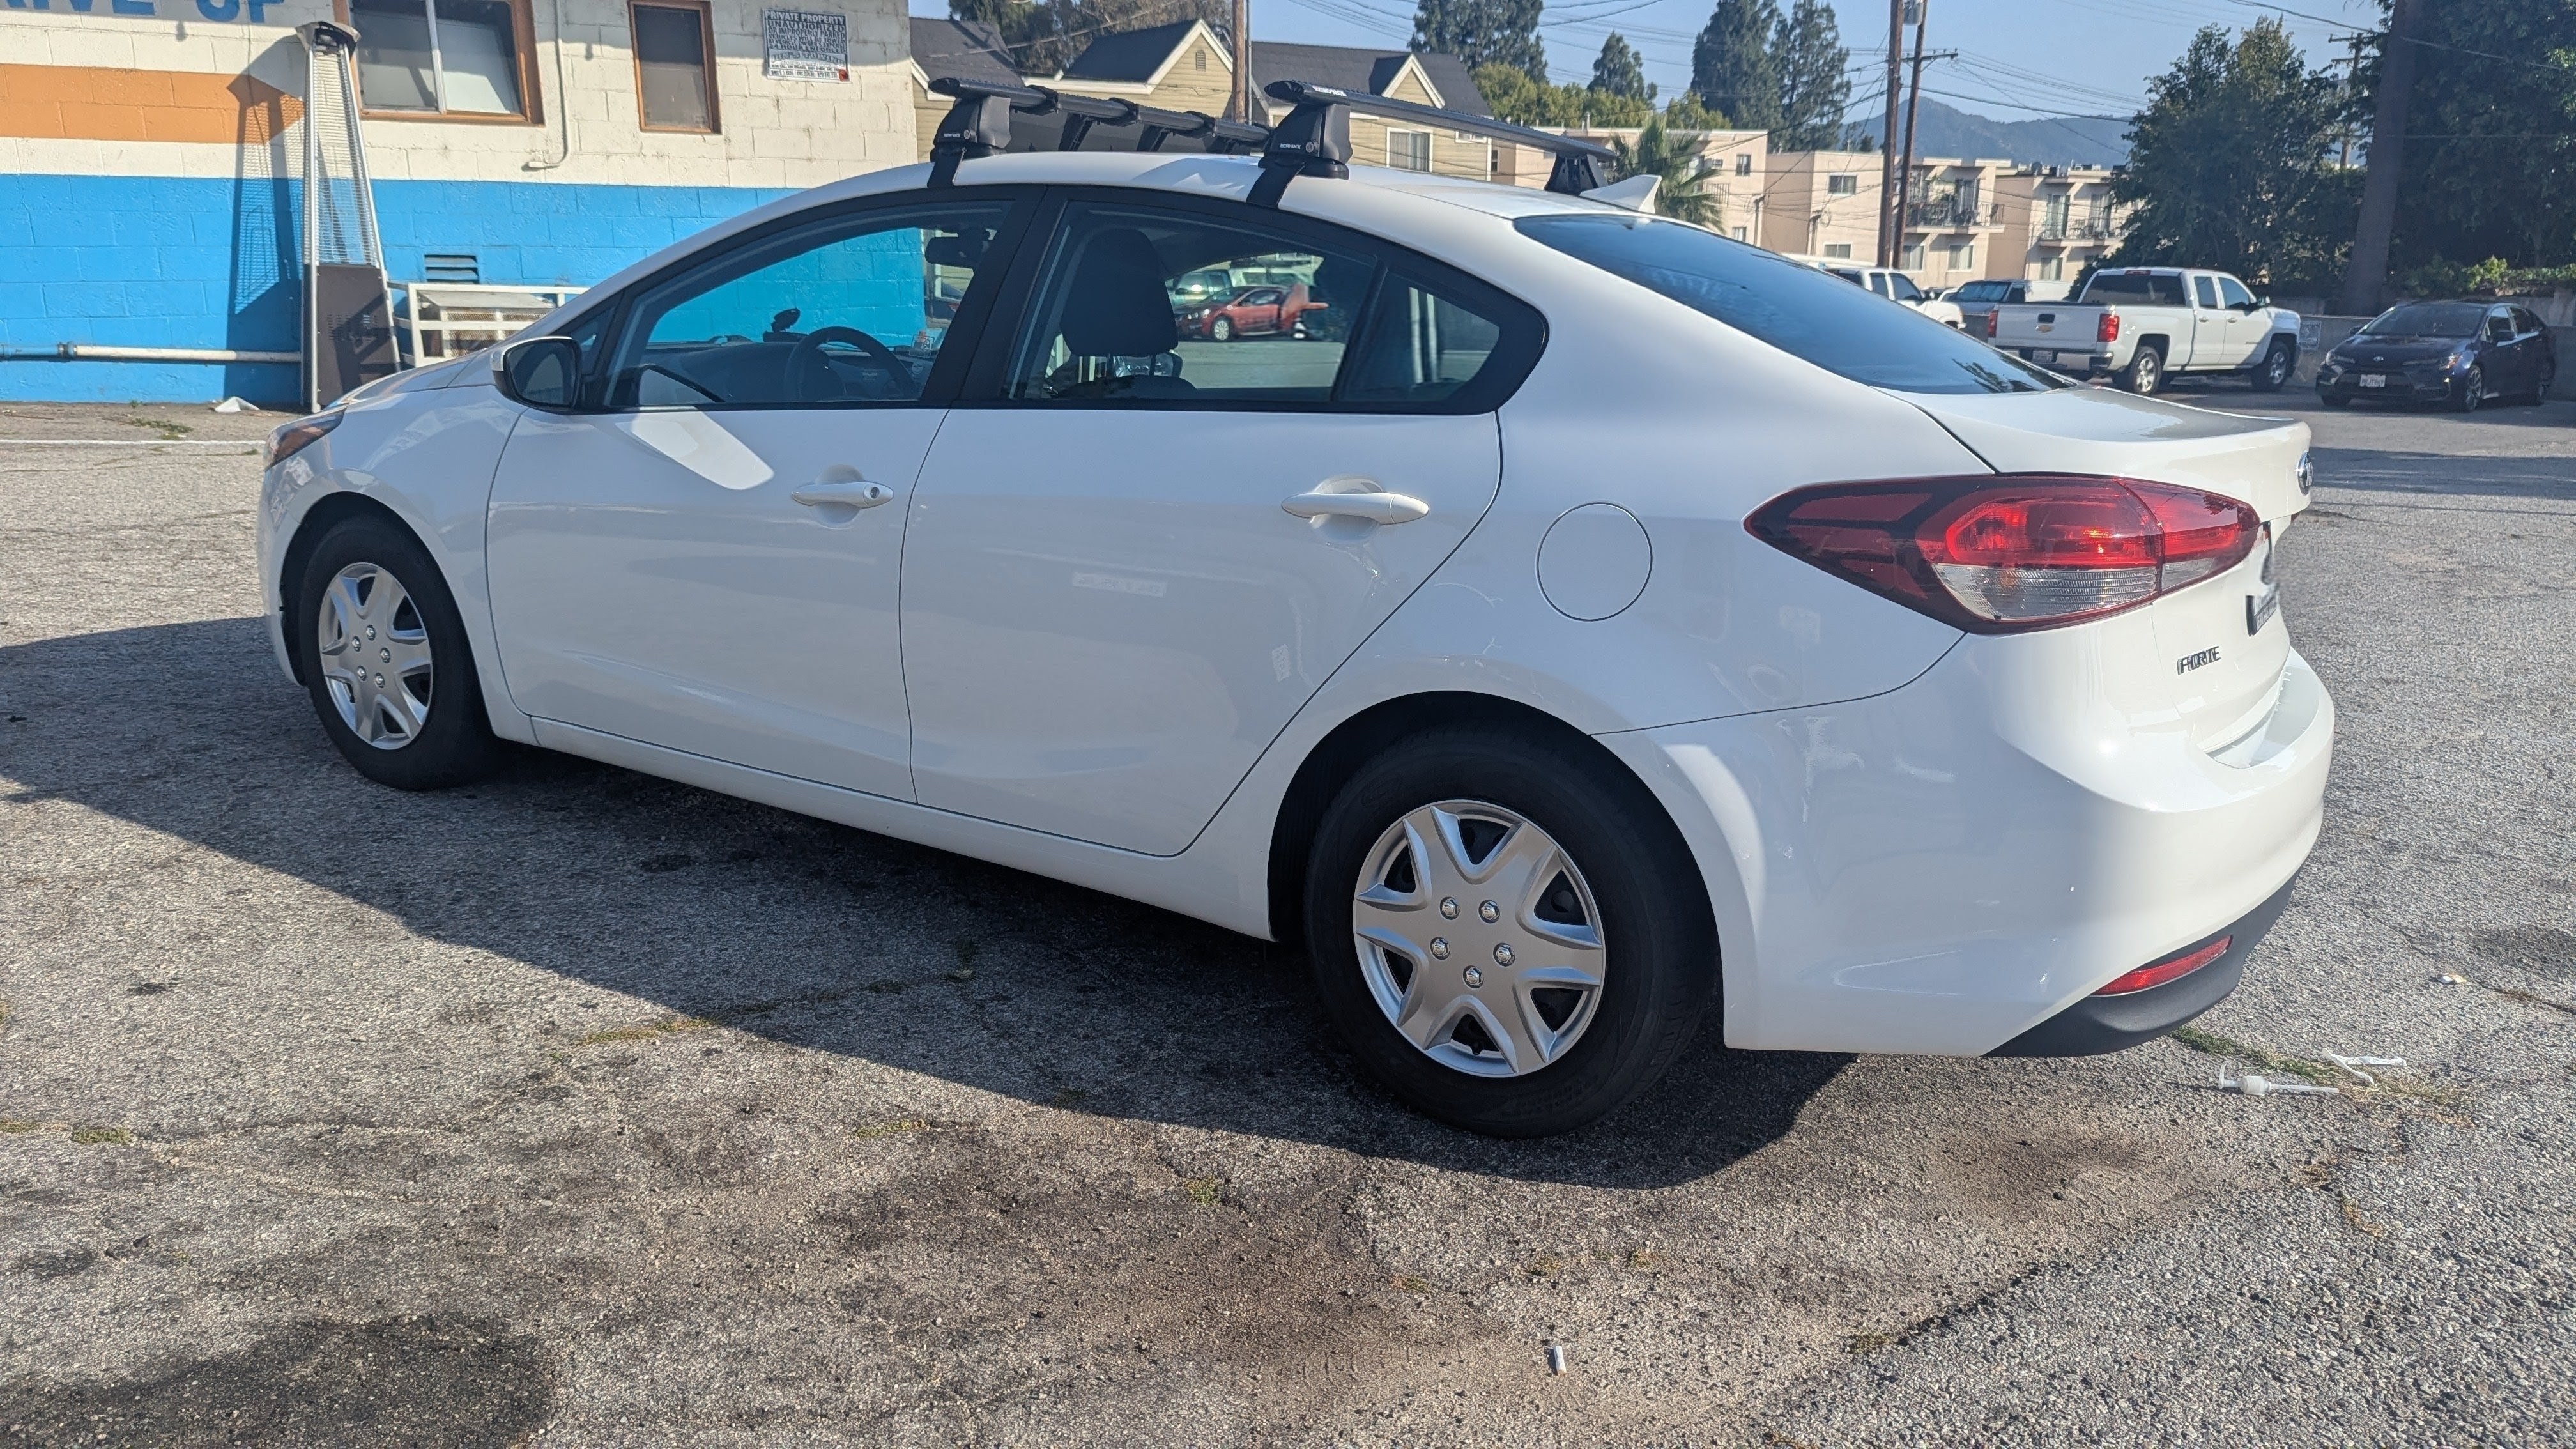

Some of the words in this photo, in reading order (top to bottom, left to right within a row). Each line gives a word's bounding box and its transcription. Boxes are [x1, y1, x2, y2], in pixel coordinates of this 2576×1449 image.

[765, 11, 799, 21] PRIVATE
[801, 13, 844, 24] PROPERTY
[768, 20, 845, 32] UNAUTHORIZED
[779, 27, 818, 37] IMPROPERLY
[821, 30, 845, 39] PARKED
[2177, 645, 2221, 675] FORTE
